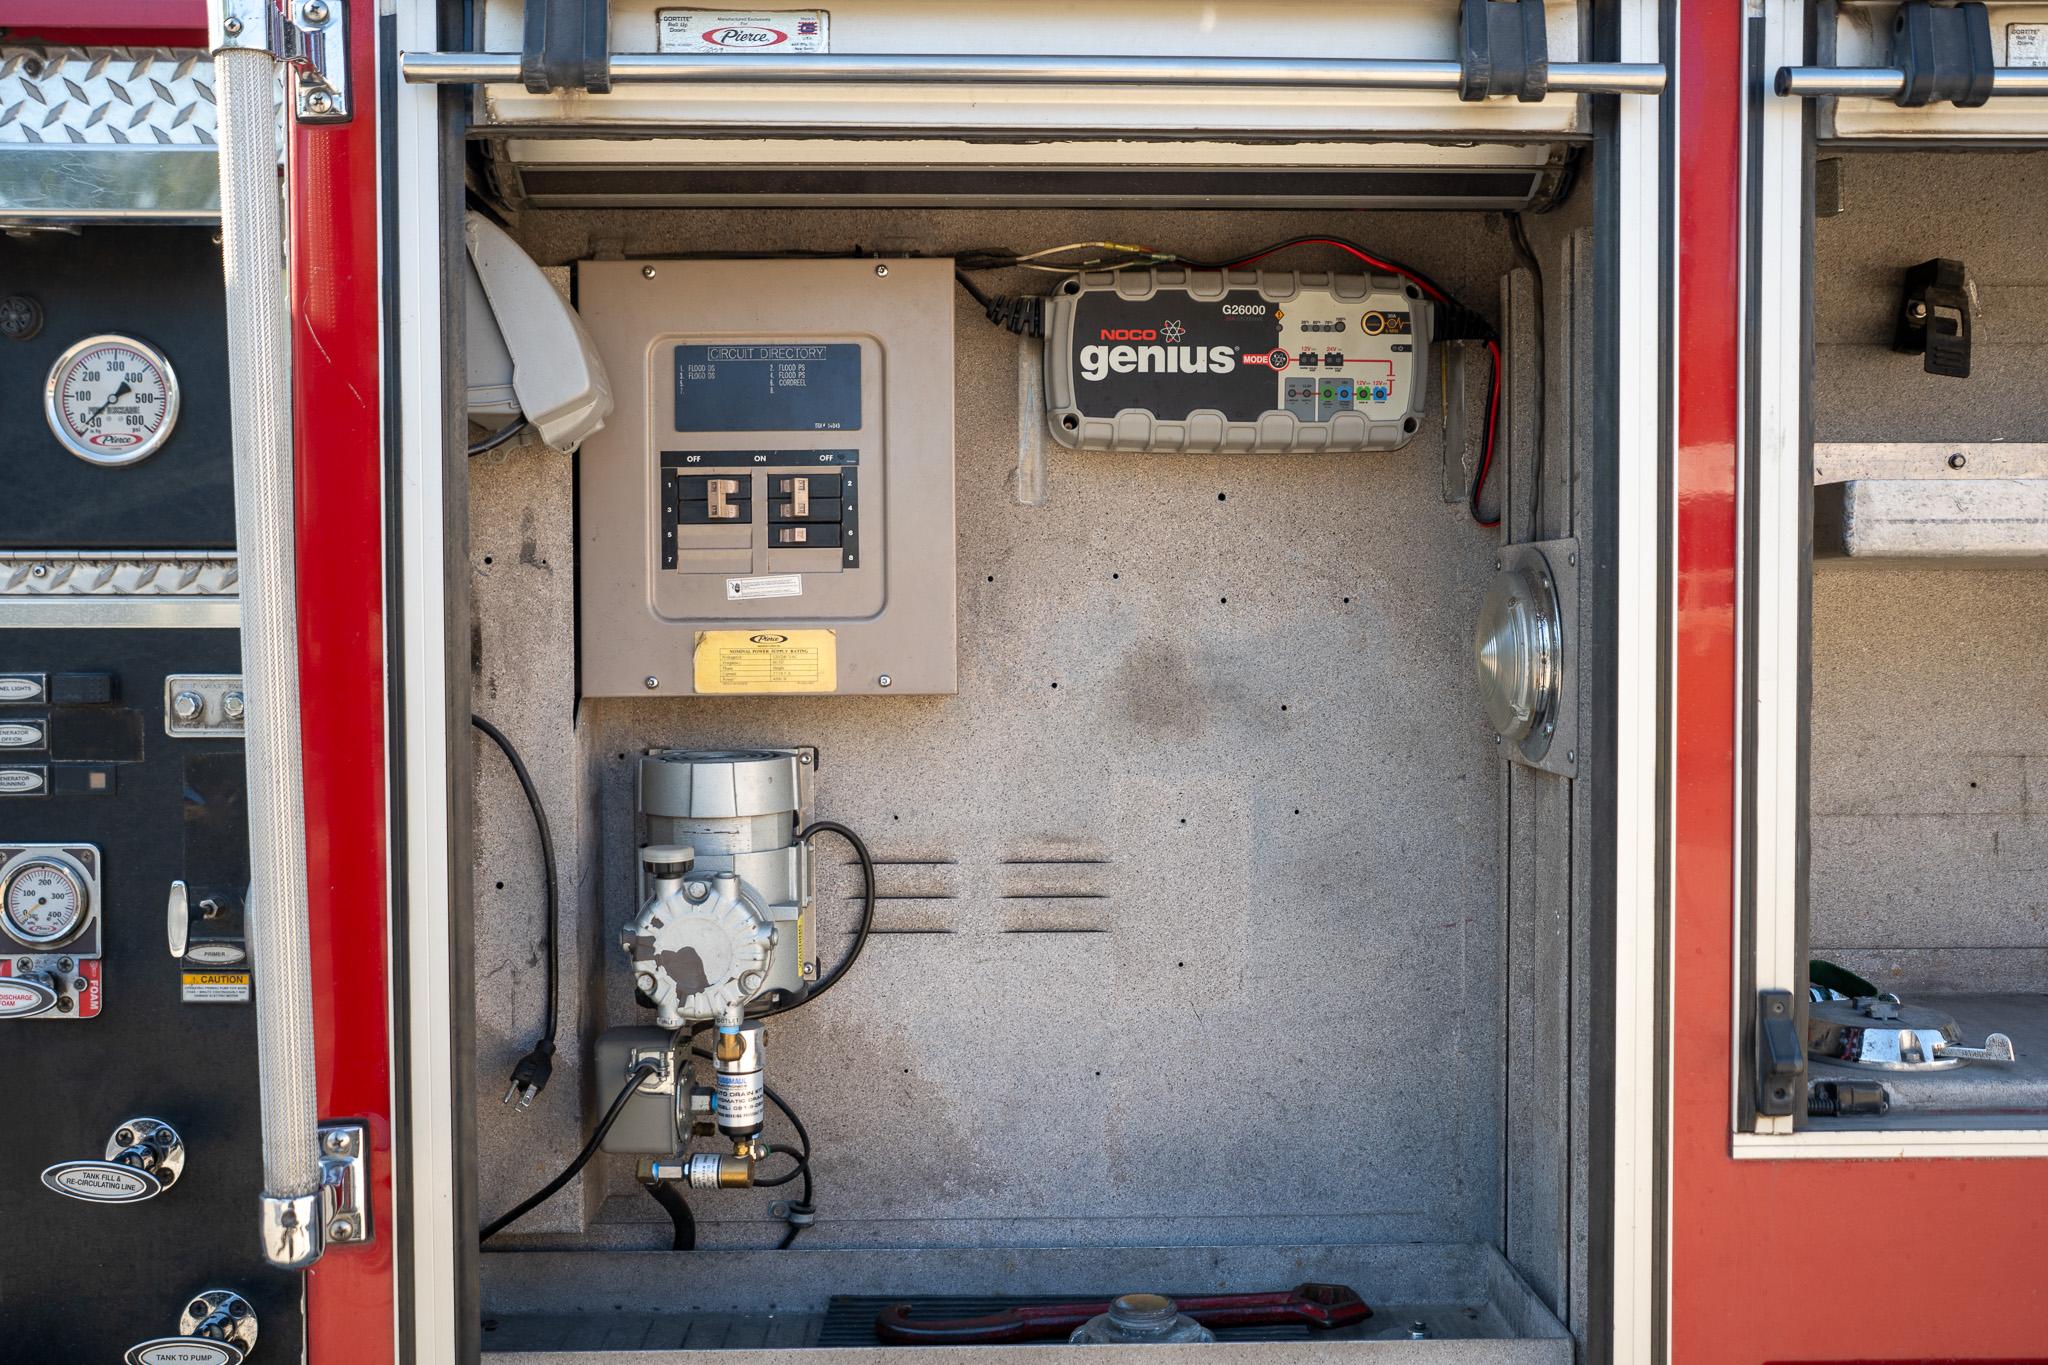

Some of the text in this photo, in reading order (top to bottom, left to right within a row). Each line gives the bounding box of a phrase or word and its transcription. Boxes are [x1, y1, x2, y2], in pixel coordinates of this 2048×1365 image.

[720, 29, 769, 44] Pierce
[1222, 305, 1266, 315] G26000
[1101, 330, 1157, 340] NOCO
[710, 348, 824, 359] CIRCUIT DIRECTORY
[1080, 345, 1235, 381] genius
[1243, 355, 1269, 364] MODE
[106, 361, 125, 371] 300
[82, 371, 100, 382] 200
[124, 372, 142, 383] 400
[75, 391, 91, 401] 100
[136, 393, 154, 403] 500
[80, 413, 86, 423] 0
[126, 415, 144, 425] 600
[102, 435, 132, 444] Pierce
[200, 975, 243, 984] CAUTION
[90, 980, 99, 1010] FOAM
[83, 1172, 100, 1180] TANK
[102, 1174, 115, 1182] FILL
[66, 1178, 120, 1190] RE-CIRCULATING
